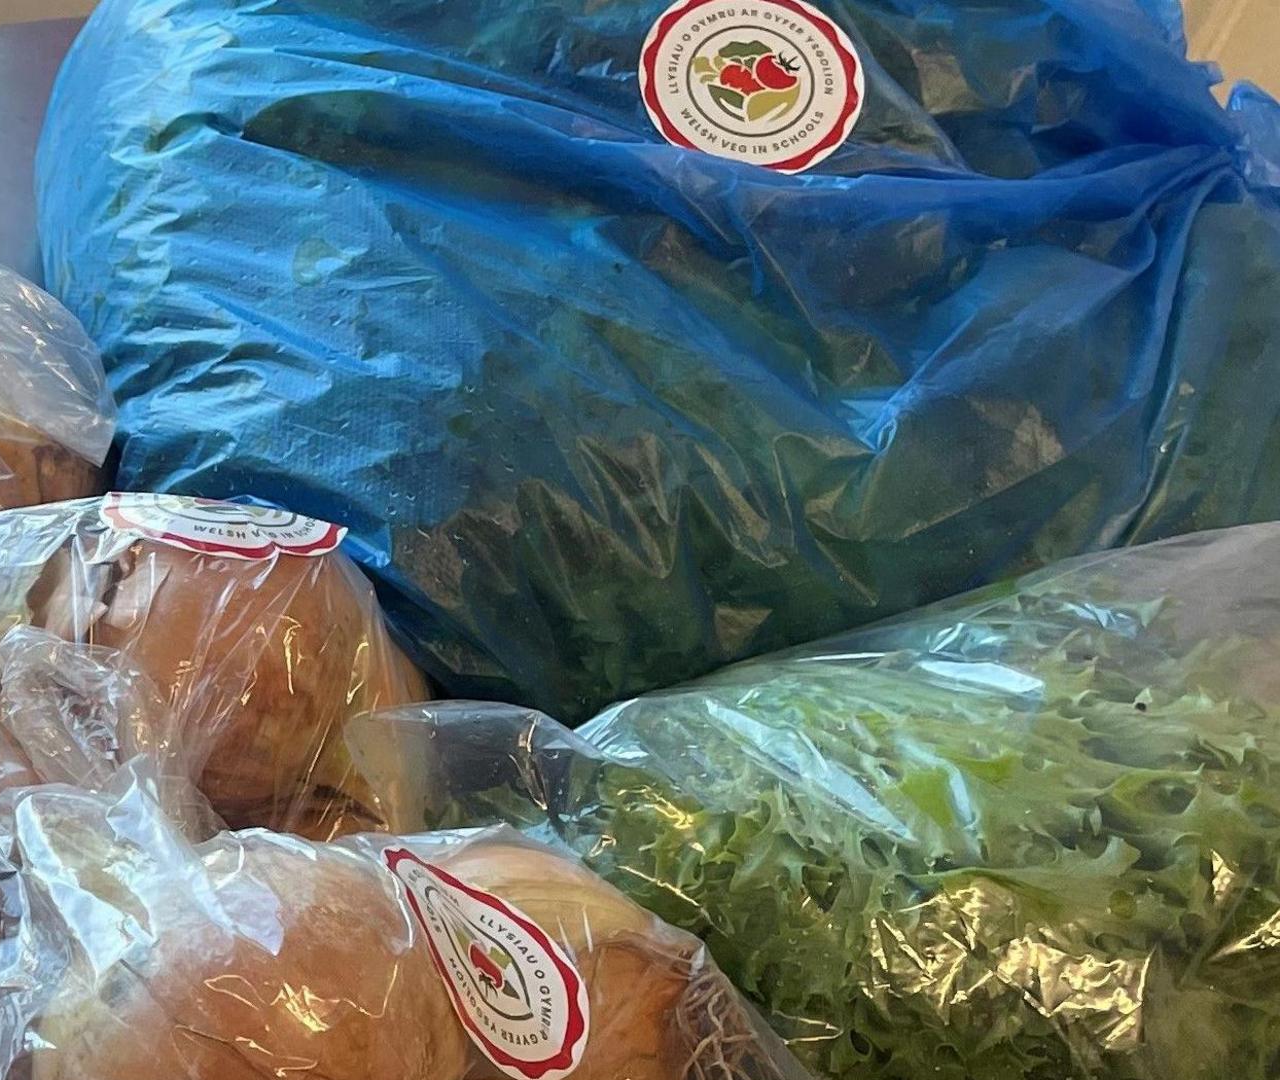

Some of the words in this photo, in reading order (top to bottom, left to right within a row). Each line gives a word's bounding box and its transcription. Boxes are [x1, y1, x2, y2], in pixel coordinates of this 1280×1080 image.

[668, 43, 684, 95] LLYSIAU
[683, 33, 692, 42] O
[691, 9, 736, 33] GYMRU
[763, 12, 805, 36] GYFER
[807, 34, 833, 95] YSGOLION
[679, 107, 717, 143] WELSH
[721, 141, 747, 154] VEG
[752, 144, 768, 155] IN
[772, 111, 824, 151] SCHOOLS
[194, 525, 246, 539] WELSH
[479, 915, 538, 965] LLYSIAU
[535, 970, 545, 979] O
